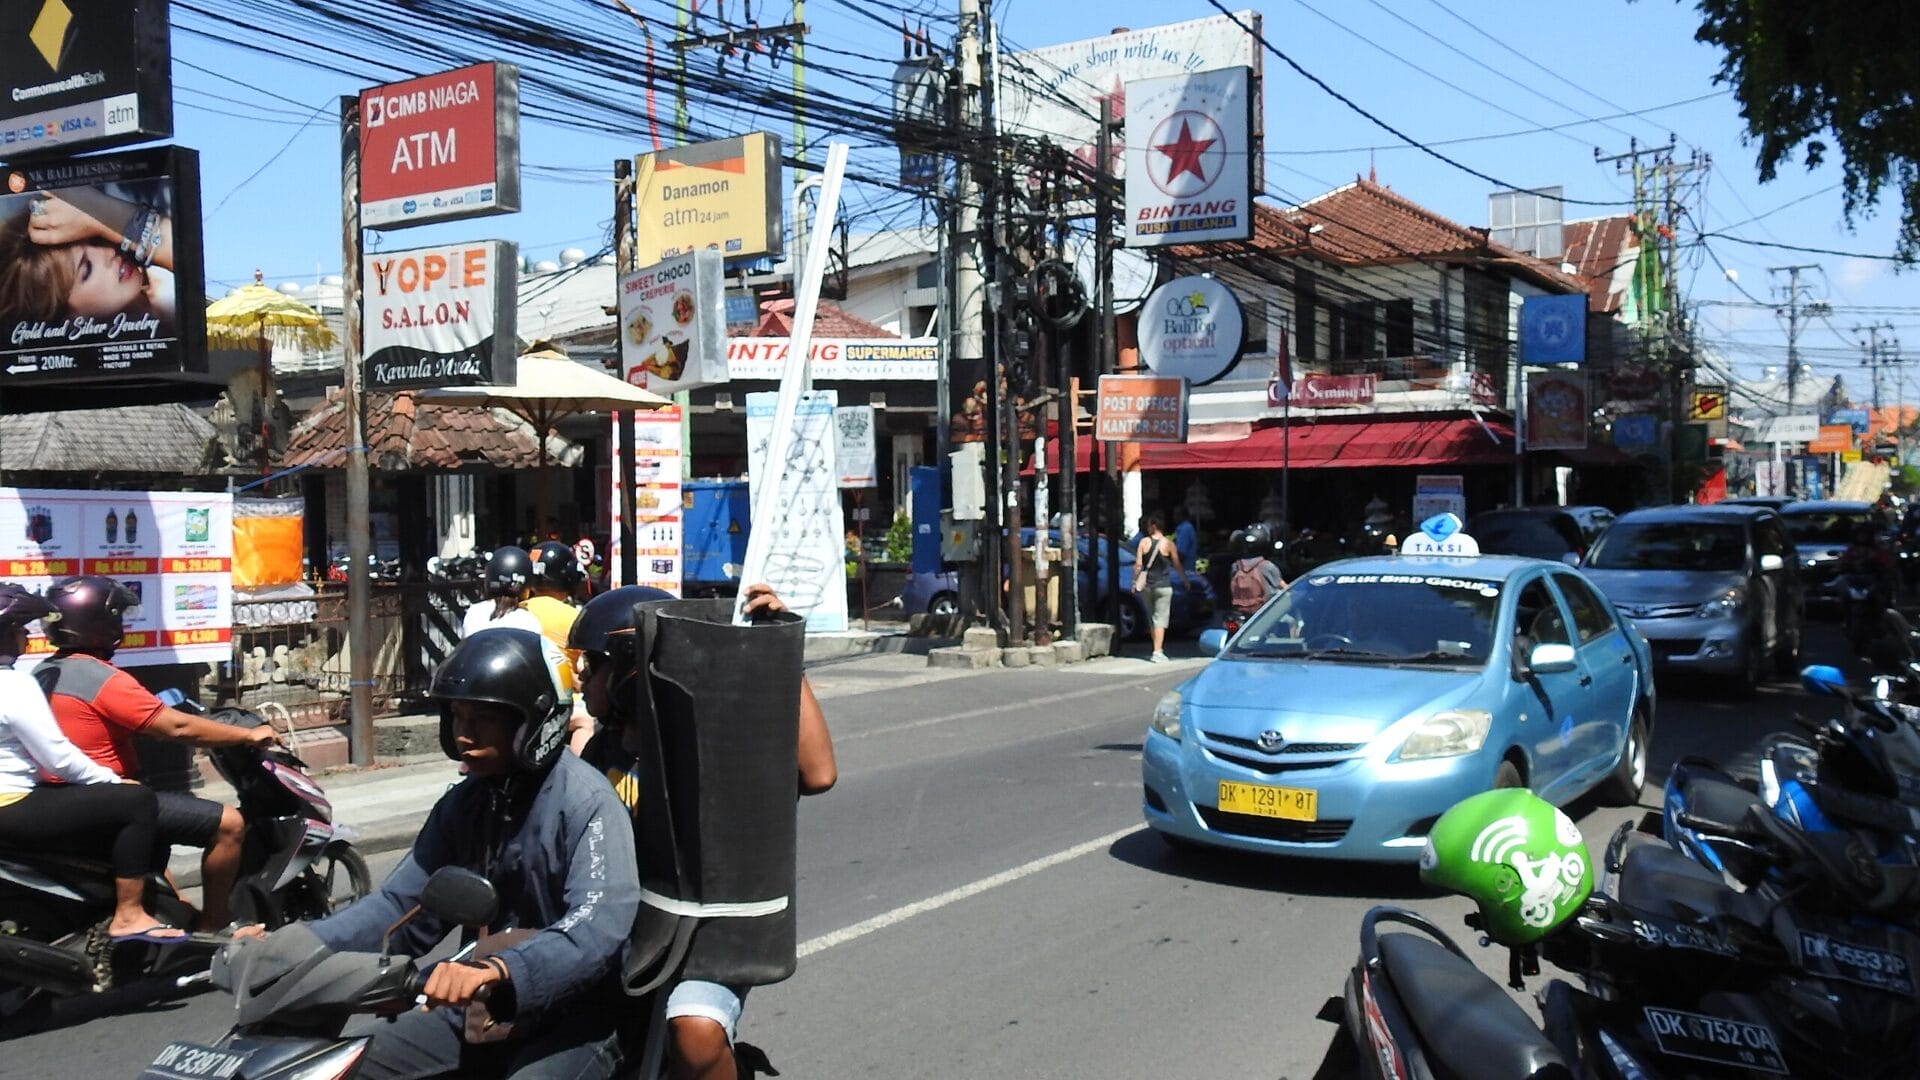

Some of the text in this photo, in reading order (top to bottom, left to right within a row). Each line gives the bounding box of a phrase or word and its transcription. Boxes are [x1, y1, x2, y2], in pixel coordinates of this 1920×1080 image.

[1086, 42, 1118, 66] shop
[1124, 33, 1158, 59] with
[1162, 50, 1178, 64] us
[387, 80, 479, 119] CIMB NIAGA
[61, 118, 82, 132] VISA
[108, 106, 134, 124] atm
[391, 127, 456, 173] ATM
[663, 179, 729, 201] Danamon
[663, 207, 698, 227] atm
[1138, 199, 1235, 221] BINTANG
[1137, 217, 1233, 233] PUSAT BELANJA
[625, 274, 655, 294] SWEET
[657, 262, 691, 283] CHOCO
[12, 312, 160, 345] Gold and Silver Jewelry
[375, 356, 431, 384] Kawula
[1103, 396, 1177, 411] POST OFFICE
[1102, 419, 1176, 434] KANTOR POS
[1416, 543, 1462, 553] TAKSI
[1337, 575, 1489, 590] BLUE BIRD GROUP
[1220, 784, 1236, 802] DK
[1252, 787, 1282, 807] 1291
[1804, 936, 1831, 957] DK
[1651, 1011, 1688, 1038] DK
[152, 1044, 188, 1066] DK
